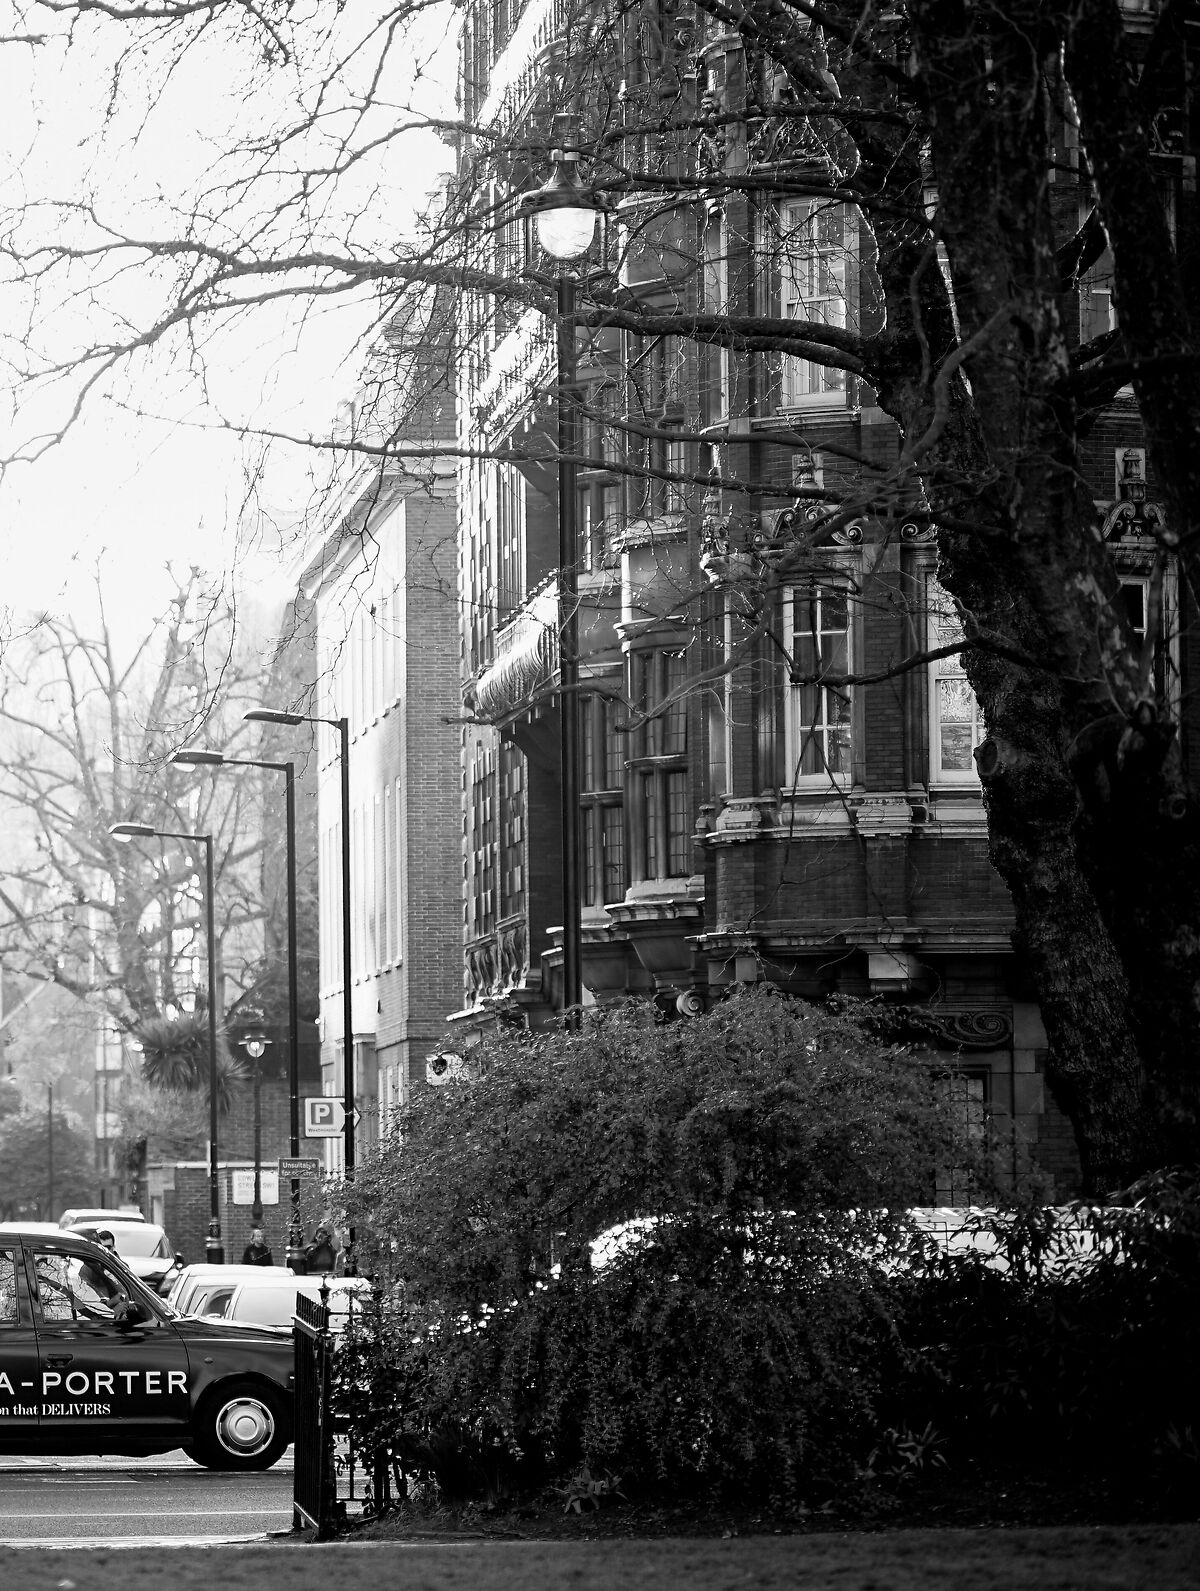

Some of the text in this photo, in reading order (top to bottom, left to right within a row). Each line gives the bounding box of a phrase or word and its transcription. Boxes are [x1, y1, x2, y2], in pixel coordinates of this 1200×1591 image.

[315, 1104, 330, 1124] P
[12, 1403, 39, 1416] that
[42, 1403, 111, 1416] DELIVERS
